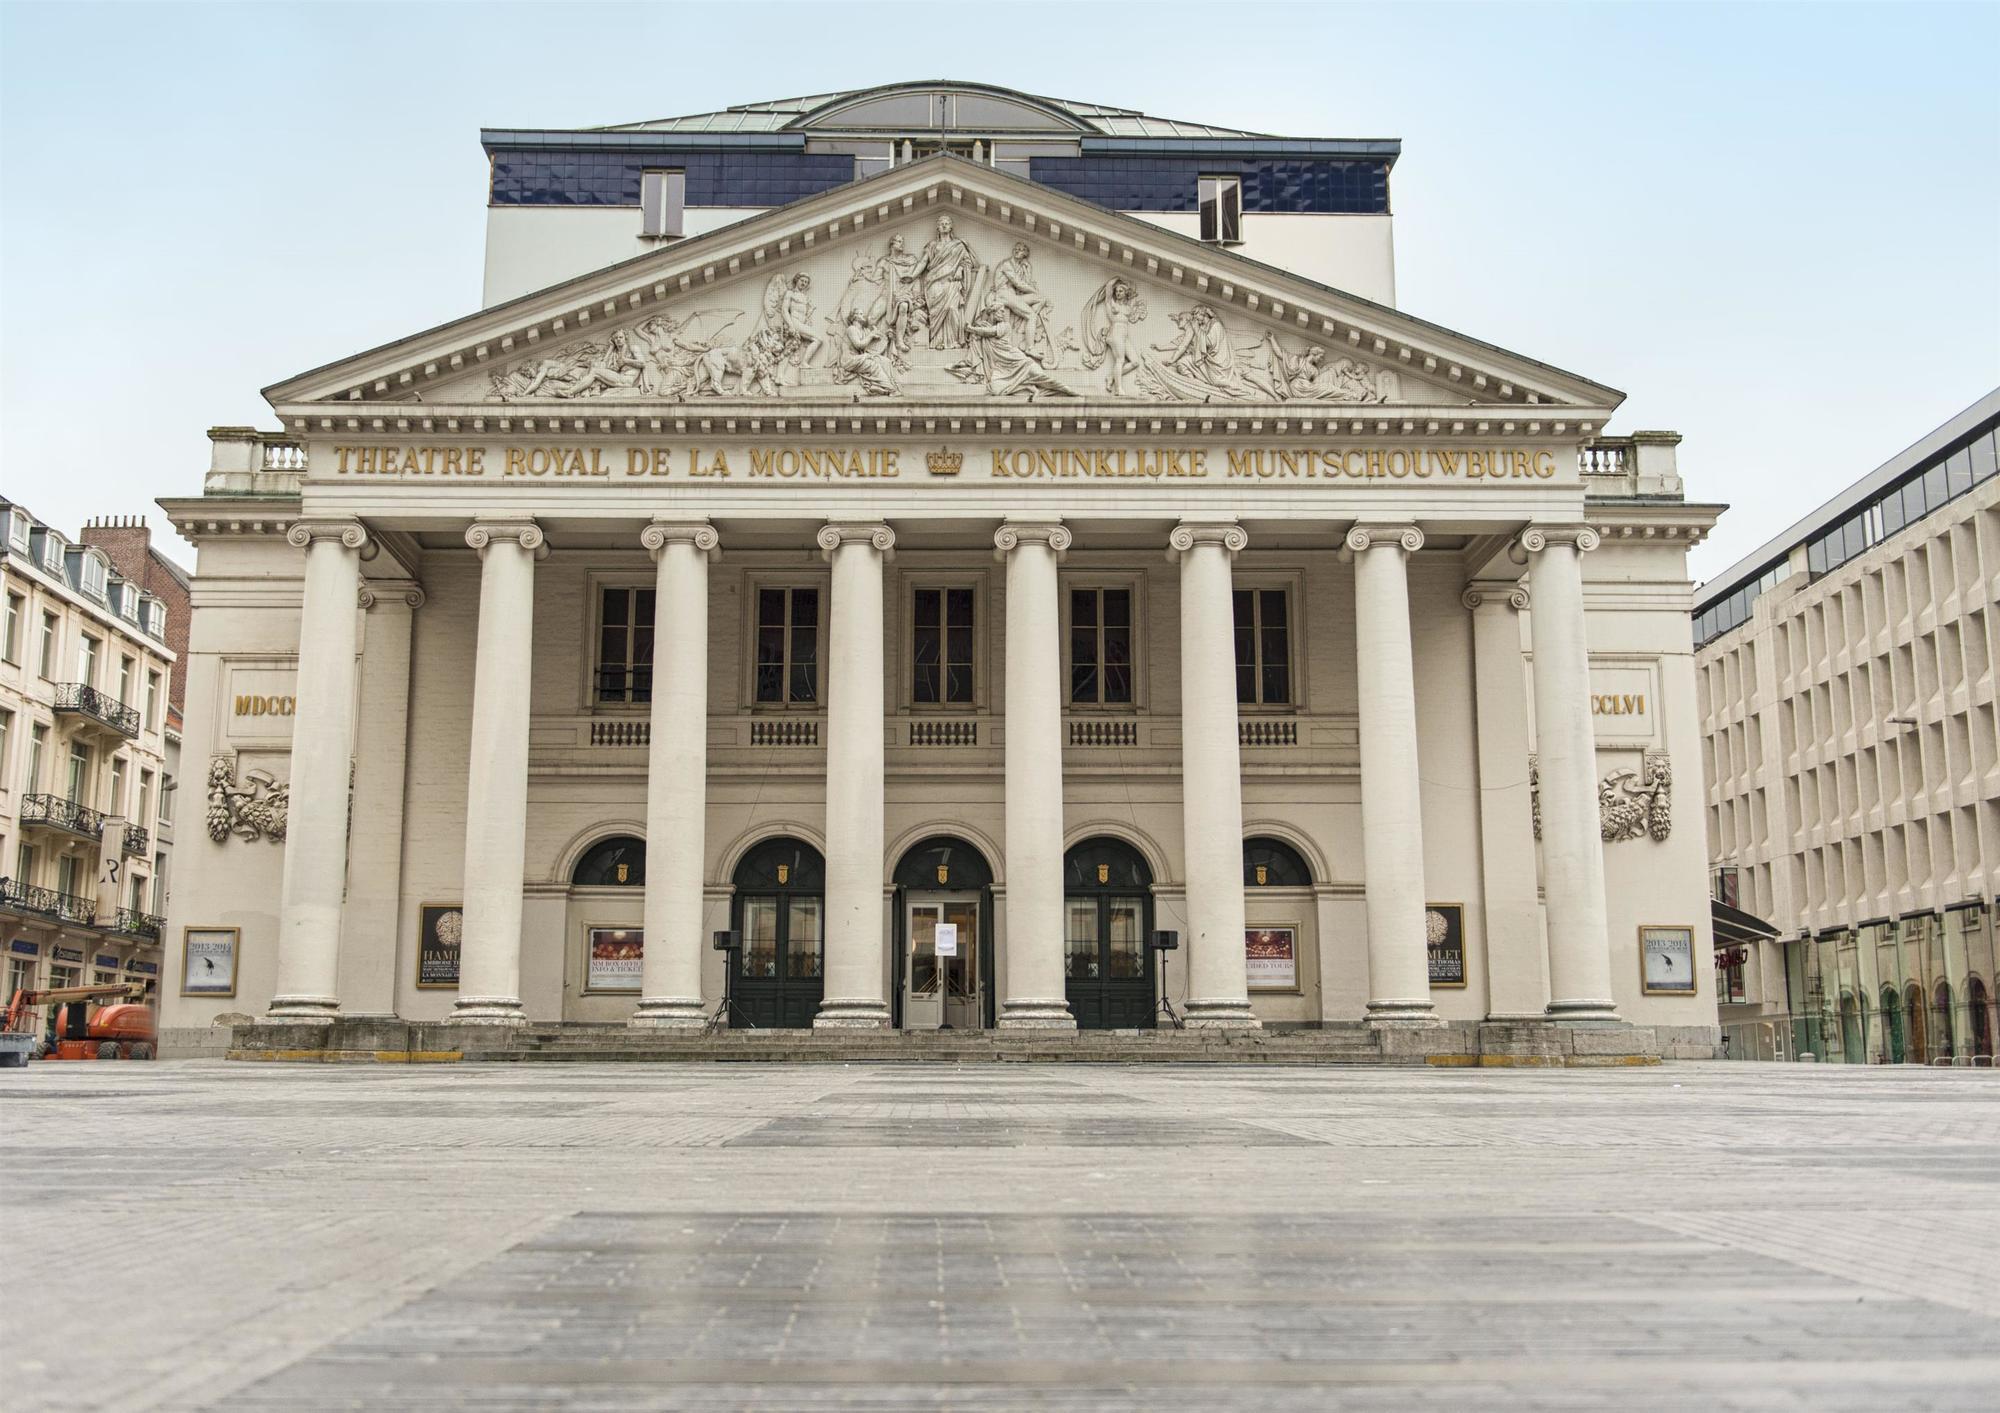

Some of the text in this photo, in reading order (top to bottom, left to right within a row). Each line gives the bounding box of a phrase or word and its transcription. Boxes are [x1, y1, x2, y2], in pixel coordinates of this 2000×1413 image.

[334, 446, 900, 477] THEATRE ROYAL DE LA MONNAIE
[990, 448, 1556, 478] KONINKLIJKE MUNTSCHOUWBURG
